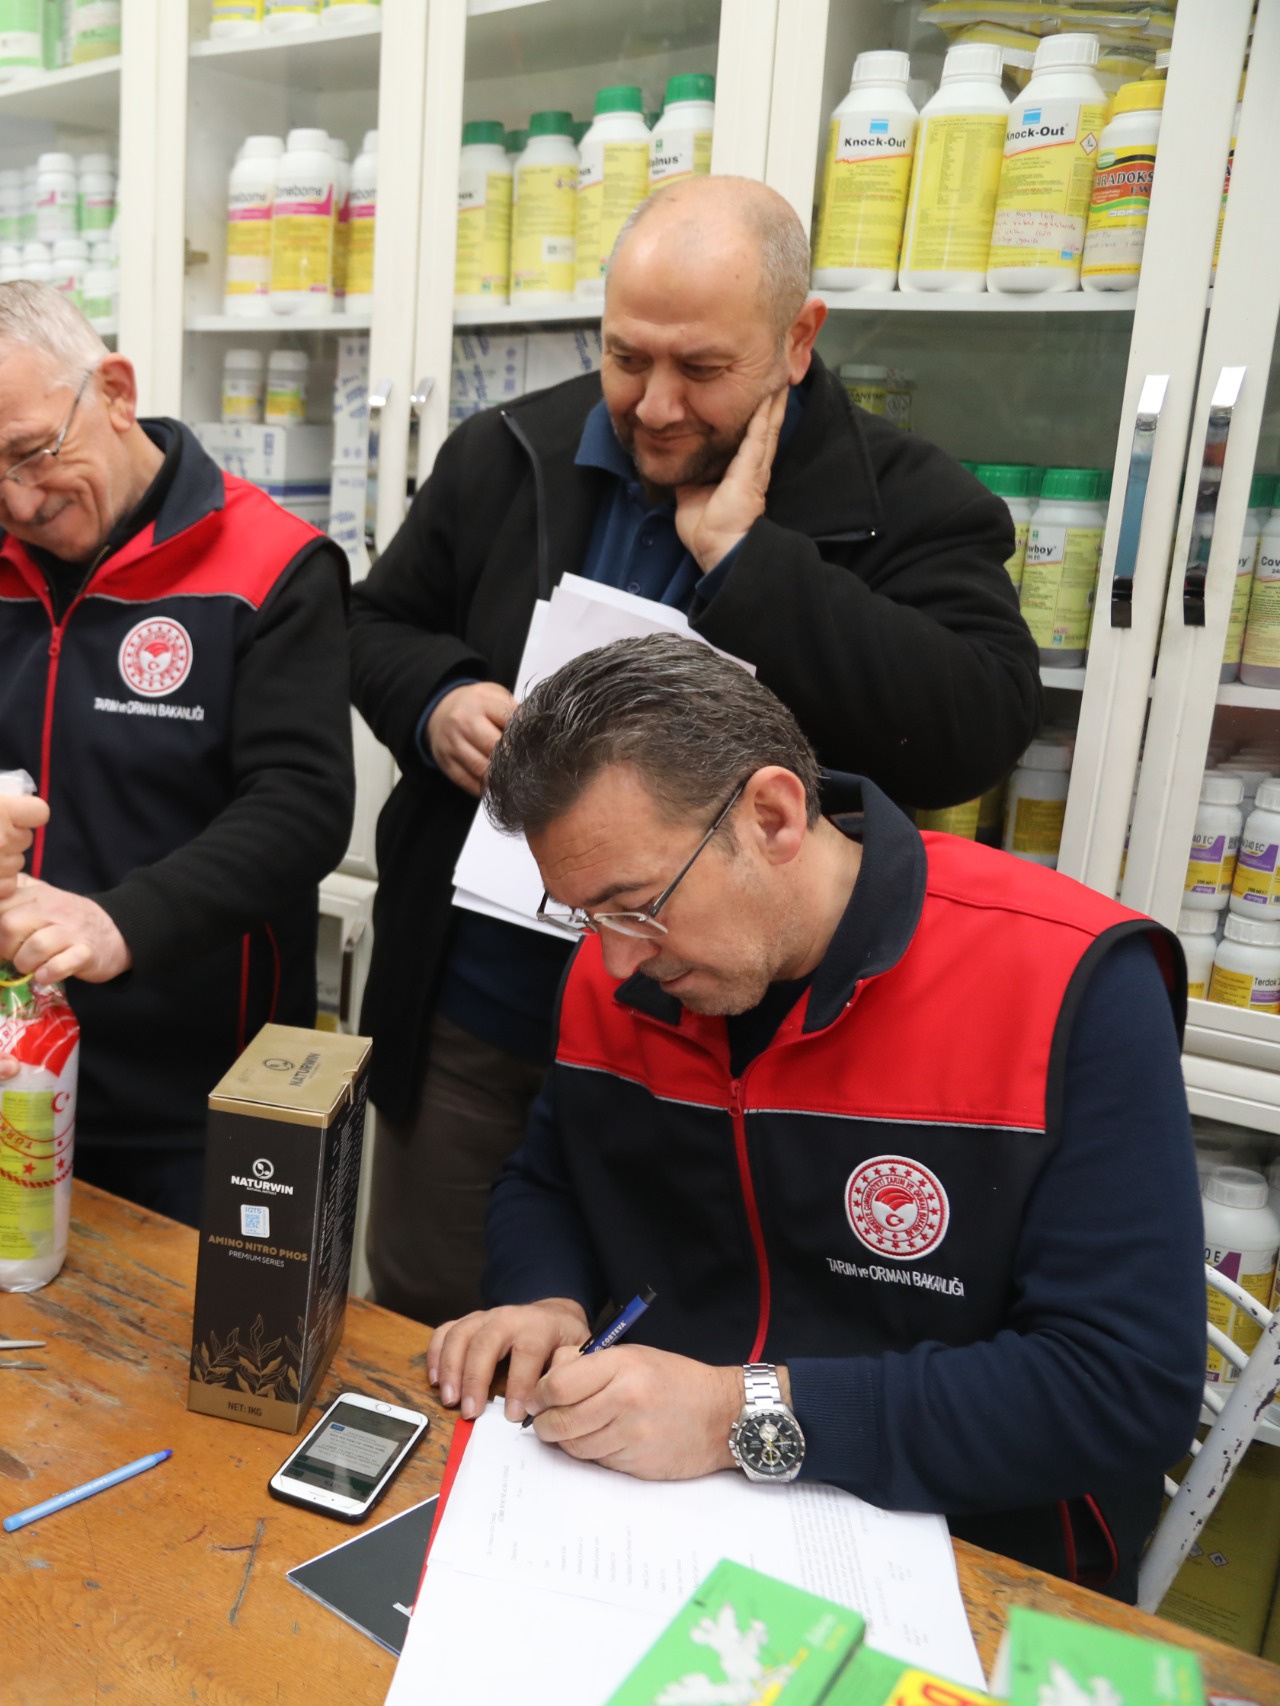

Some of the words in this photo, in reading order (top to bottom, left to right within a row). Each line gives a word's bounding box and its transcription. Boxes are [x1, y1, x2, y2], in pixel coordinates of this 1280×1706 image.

[843, 137, 907, 149] Knock-Out
[1005, 126, 1065, 142] Knock-Out
[94, 697, 118, 713] TARIM
[127, 700, 158, 717] ORMAN
[158, 702, 205, 721] BAKANLIĞI
[1203, 836, 1214, 845] EC
[1255, 842, 1265, 853] EC
[1254, 977, 1277, 987] Terdok
[230, 1175, 294, 1196] NATURWIN
[208, 1234, 244, 1248] AMINO
[245, 1241, 277, 1255] NITRO
[279, 1248, 308, 1261] PHOS
[228, 1250, 261, 1263] PREMIUM
[262, 1257, 285, 1268] SERIES
[825, 1258, 858, 1277] TARIM
[858, 1267, 869, 1278] ve
[869, 1265, 911, 1286] ORMAN
[912, 1271, 965, 1297] BAKANLIĞI
[601, 1321, 627, 1347] CORTEVA
